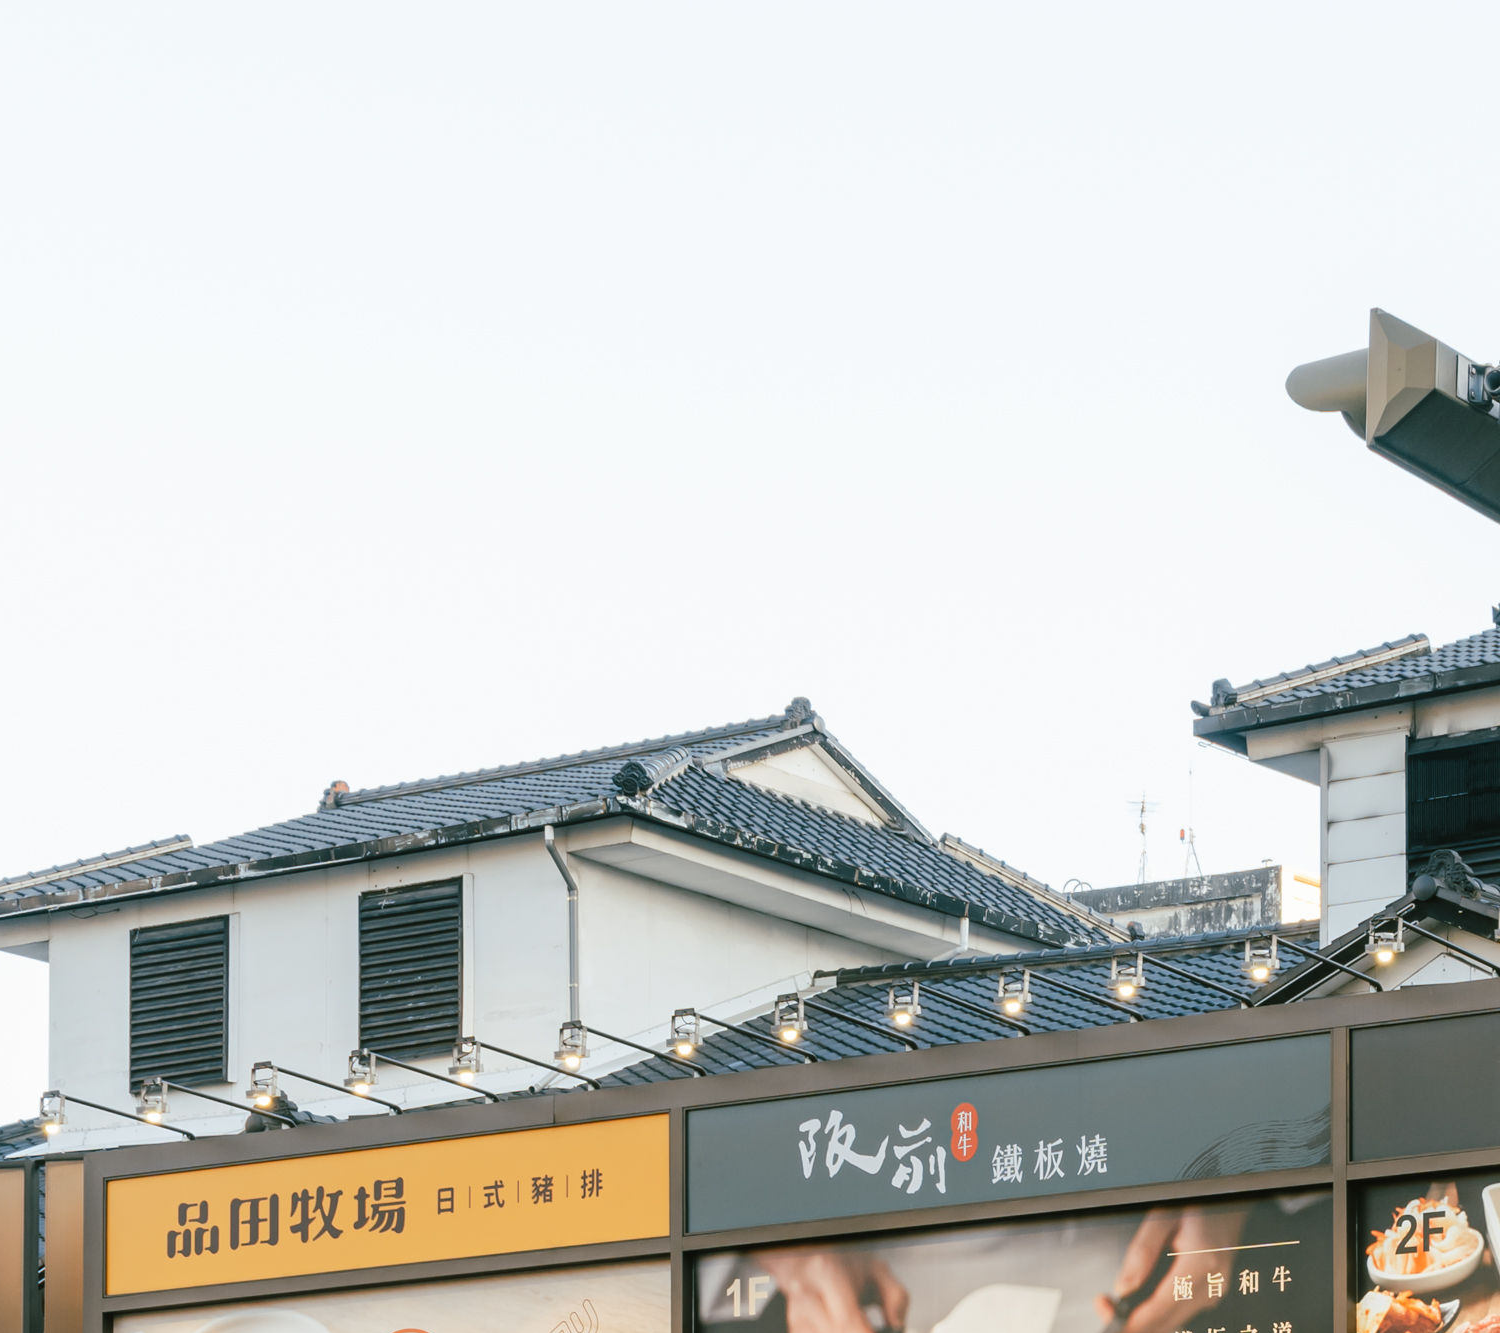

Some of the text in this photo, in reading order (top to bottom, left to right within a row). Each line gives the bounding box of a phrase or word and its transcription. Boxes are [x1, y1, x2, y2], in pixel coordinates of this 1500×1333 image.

[956, 1110, 975, 1158] 和牛
[990, 1132, 1111, 1186] 鐵板燒
[165, 1177, 408, 1260] 品田牧場
[1394, 1210, 1448, 1256] 2F
[725, 1274, 771, 1319] 1F
[1171, 1264, 1294, 1305] 極旨和牛
